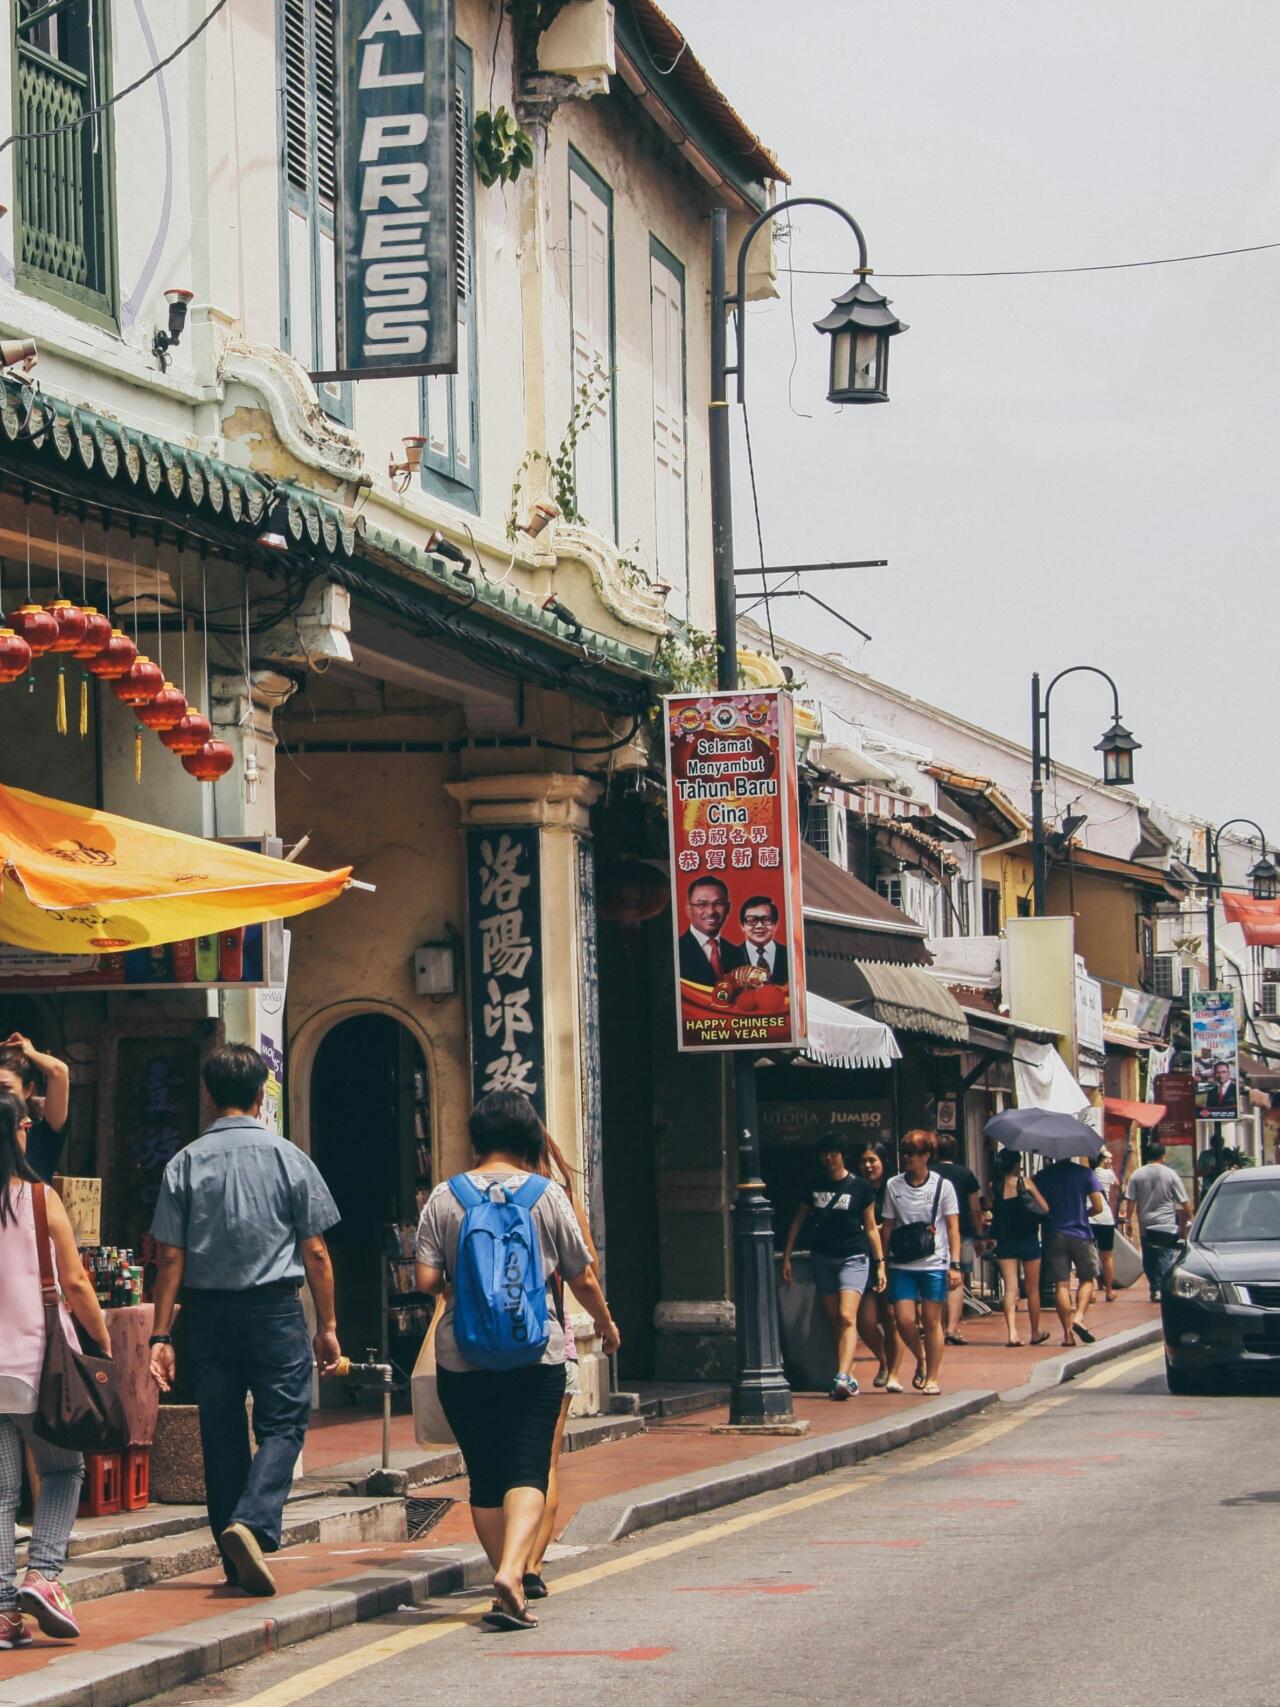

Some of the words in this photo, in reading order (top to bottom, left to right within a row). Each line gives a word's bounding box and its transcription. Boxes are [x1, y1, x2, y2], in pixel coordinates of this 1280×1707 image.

[359, 113, 431, 356] PRESS
[698, 738, 752, 753] Selamat
[688, 758, 764, 776] Menyambut
[677, 780, 730, 800] Tahun
[735, 778, 776, 797] Baru
[708, 804, 747, 823] Cina
[690, 827, 768, 846] 恭祝各界
[679, 848, 779, 870] 恭賀新禧
[686, 1019, 727, 1030] HAPPY
[731, 1017, 785, 1028] CHINESE
[701, 1030, 730, 1040] NEW
[735, 1028, 768, 1039] YEAR
[763, 1112, 819, 1125] UTOPIA
[831, 1111, 882, 1124] JUMBO
[501, 1252, 528, 1344] adidas
